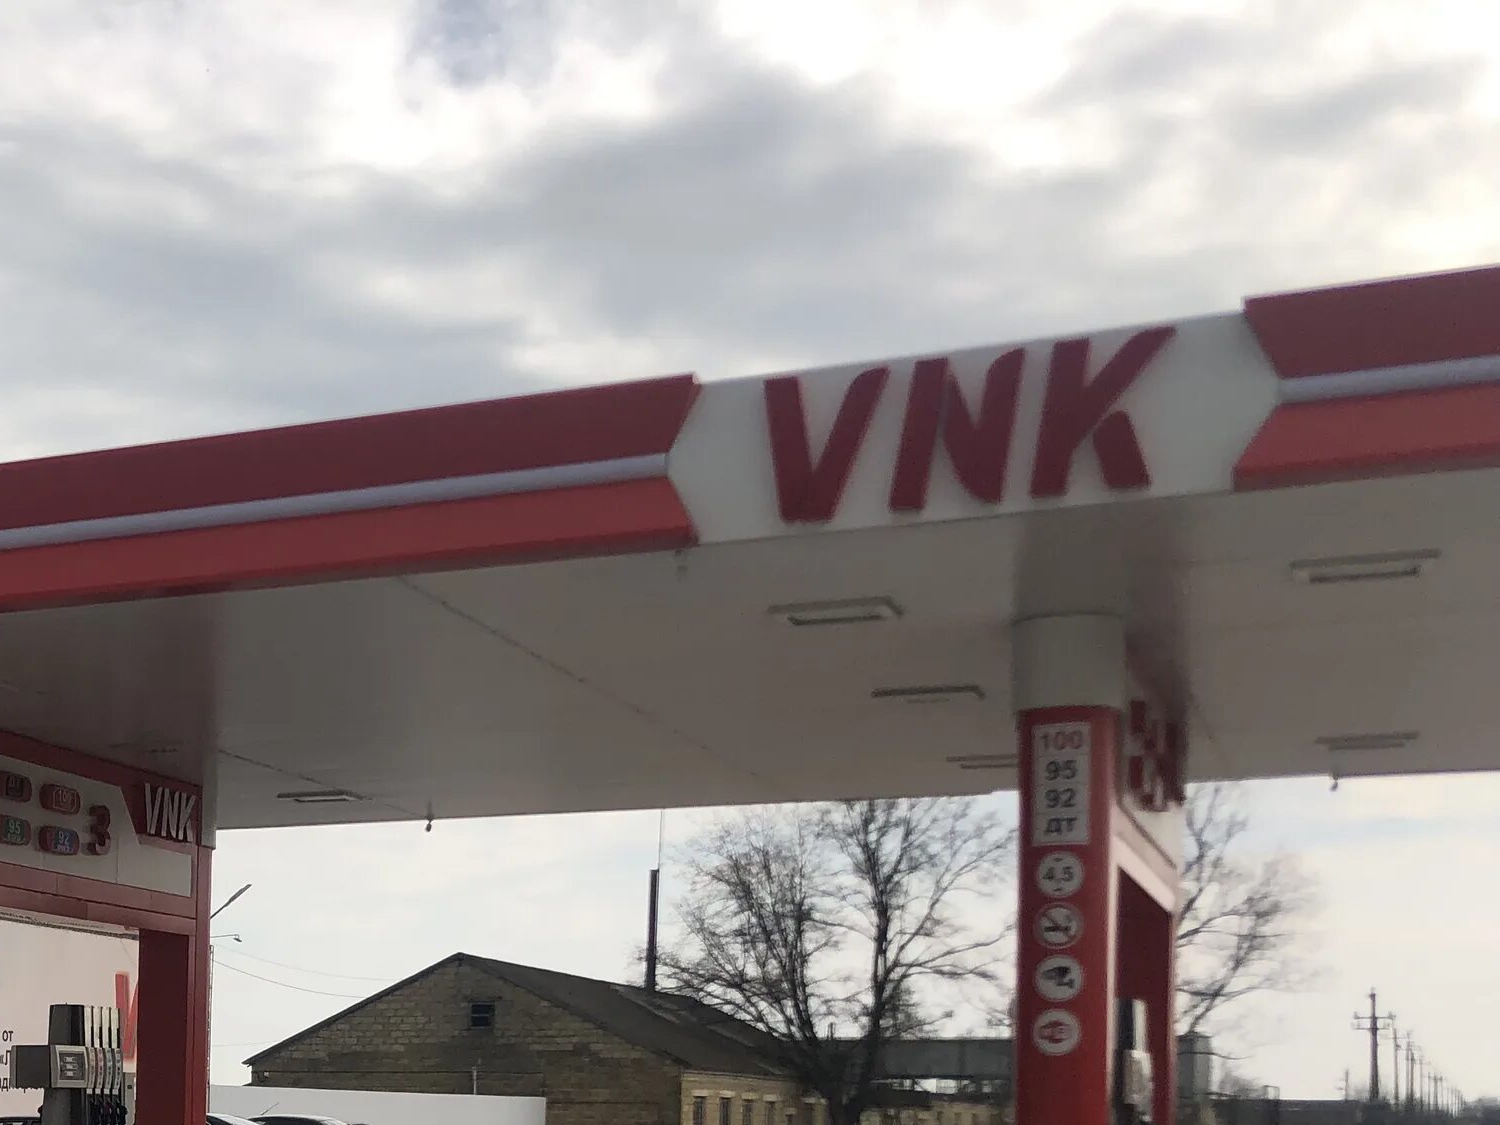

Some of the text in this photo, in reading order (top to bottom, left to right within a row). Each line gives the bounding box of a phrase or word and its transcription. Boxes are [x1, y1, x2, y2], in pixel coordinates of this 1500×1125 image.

[763, 325, 1177, 524] VNK
[1041, 730, 1084, 750] 100
[1045, 760, 1077, 781] 95
[1045, 788, 1077, 808] 92
[144, 782, 197, 842] VNK
[8, 819, 21, 834] 95
[1044, 817, 1077, 836] ДТ
[58, 830, 70, 845] 92
[2, 1029, 14, 1042] от
